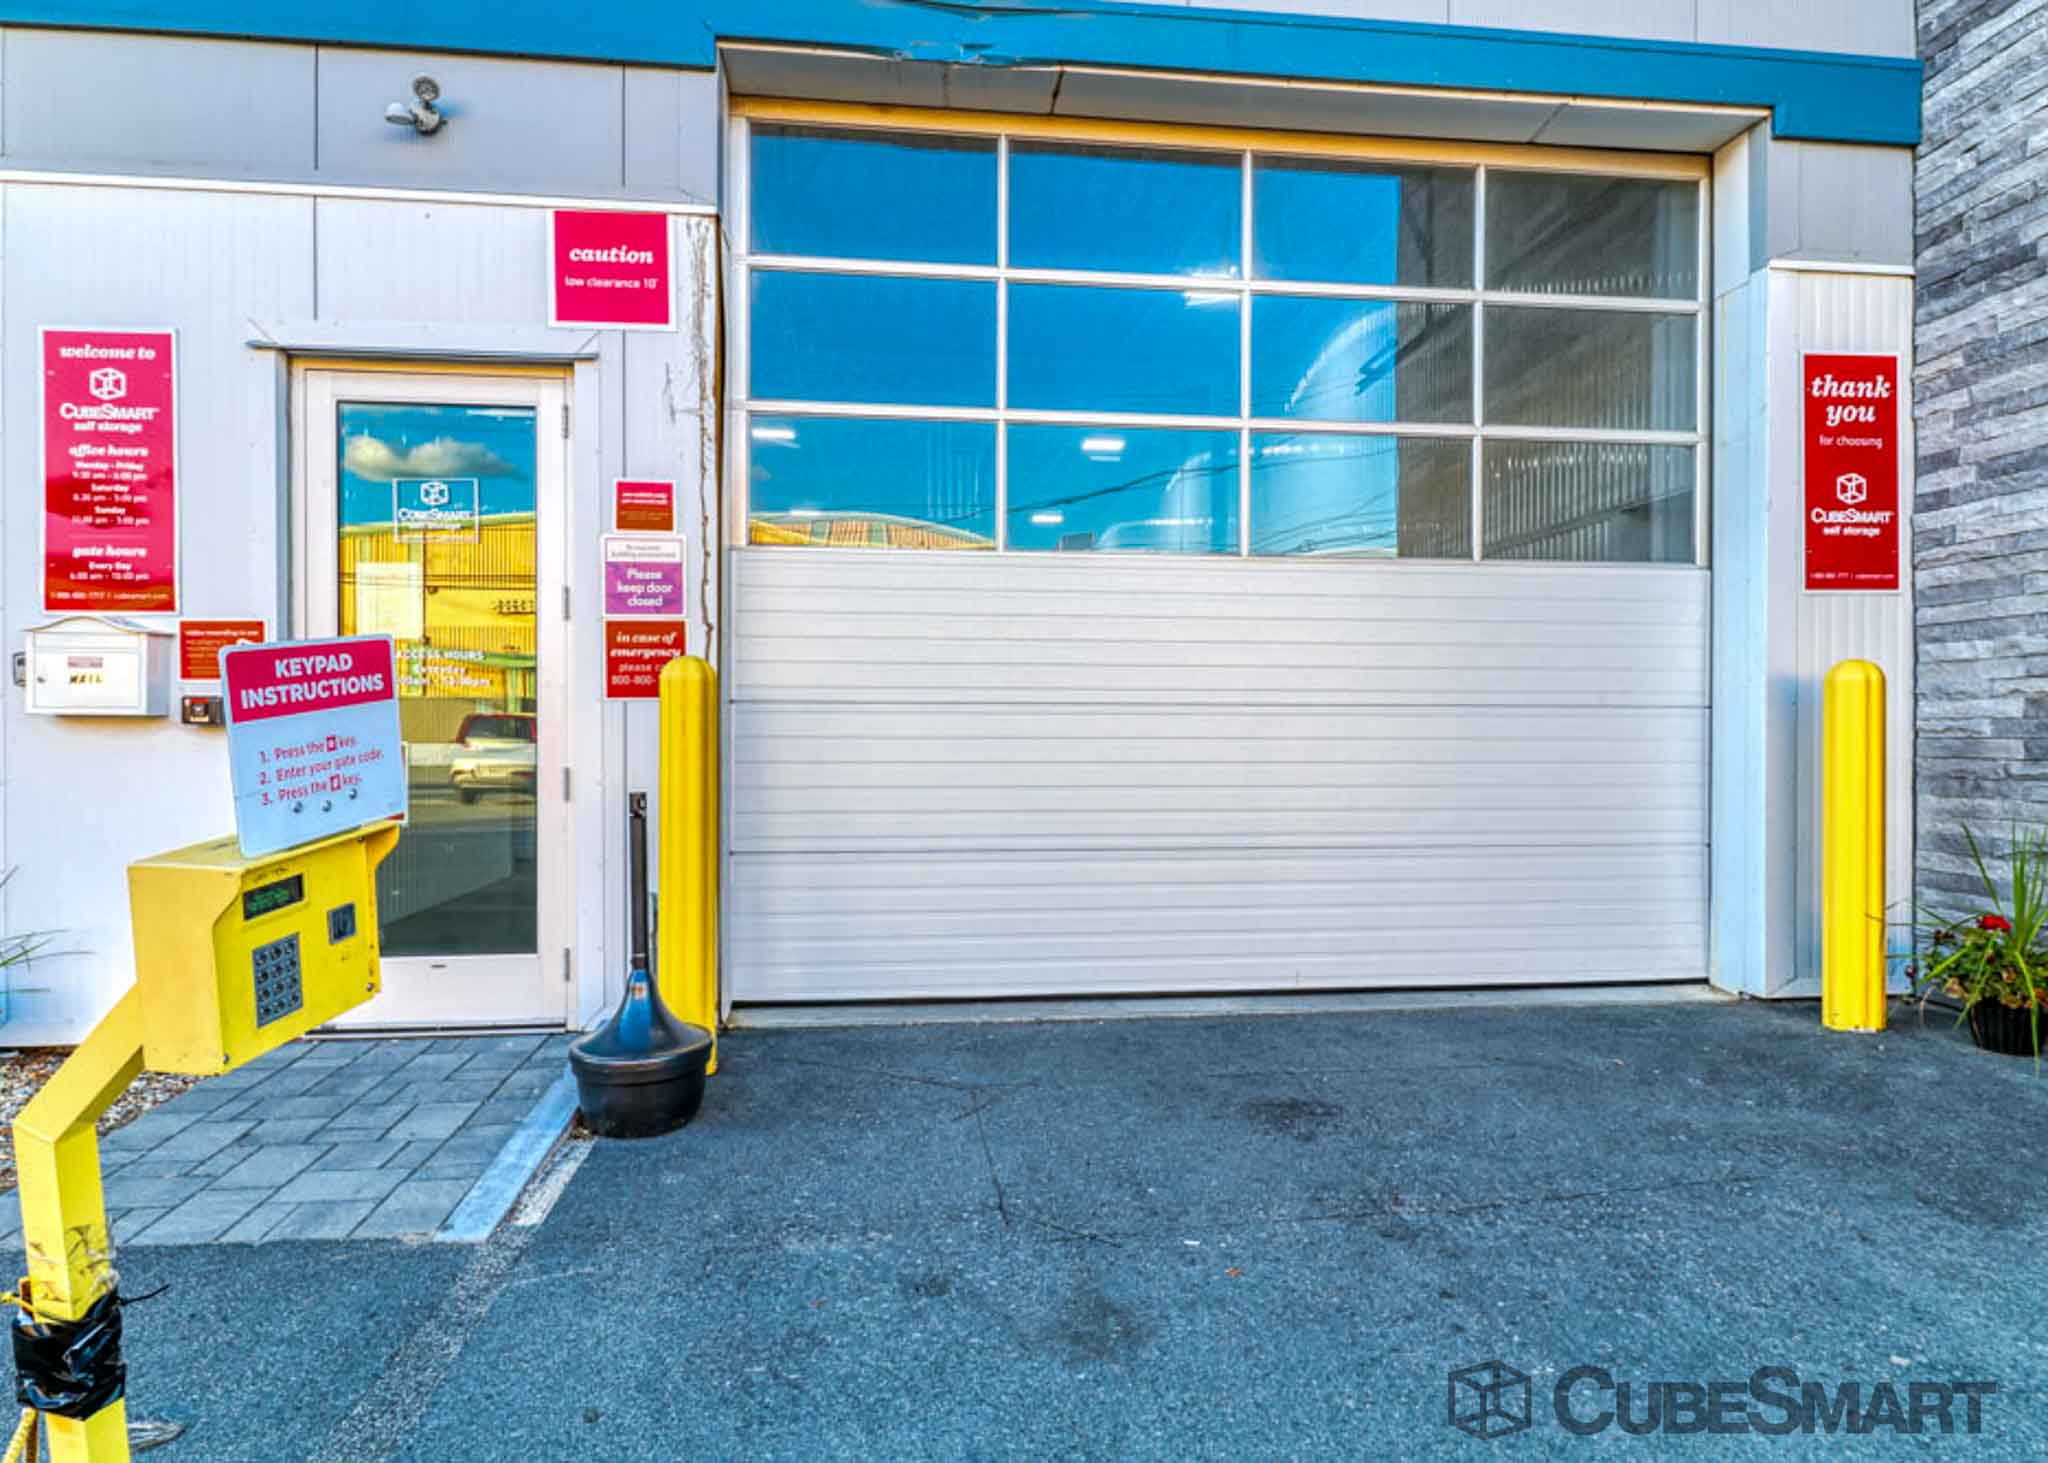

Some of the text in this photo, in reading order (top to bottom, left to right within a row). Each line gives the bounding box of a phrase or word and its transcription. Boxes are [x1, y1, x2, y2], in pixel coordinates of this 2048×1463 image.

[568, 244, 654, 264] caution
[564, 276, 585, 286] low
[587, 277, 640, 289] clearance
[60, 344, 156, 360] welcome to
[1811, 373, 1891, 399] thank
[1826, 404, 1876, 427] you
[73, 421, 143, 434] self storage
[1819, 434, 1883, 449] for choosing
[68, 444, 149, 457] office hours
[75, 461, 108, 470] Monday
[115, 461, 144, 471] Friday
[91, 483, 129, 493] Saturday
[1823, 526, 1881, 538] self storage
[72, 545, 147, 558] gate hours
[88, 561, 112, 571] Every
[627, 568, 662, 579] Please
[617, 579, 673, 594] keep door
[627, 595, 663, 606] closed
[616, 632, 677, 645] in case of
[610, 648, 681, 660] emergency
[274, 653, 352, 679] KEYPAD
[618, 663, 652, 673] please
[240, 673, 385, 709] INSTRUCTIONS
[259, 751, 270, 763] 1.
[274, 746, 305, 760] Press
[306, 742, 324, 753] the
[260, 748, 384, 785] 2. Enter your gate code.
[261, 792, 272, 806] 3.
[278, 788, 309, 800] Press
[311, 782, 327, 793] the
